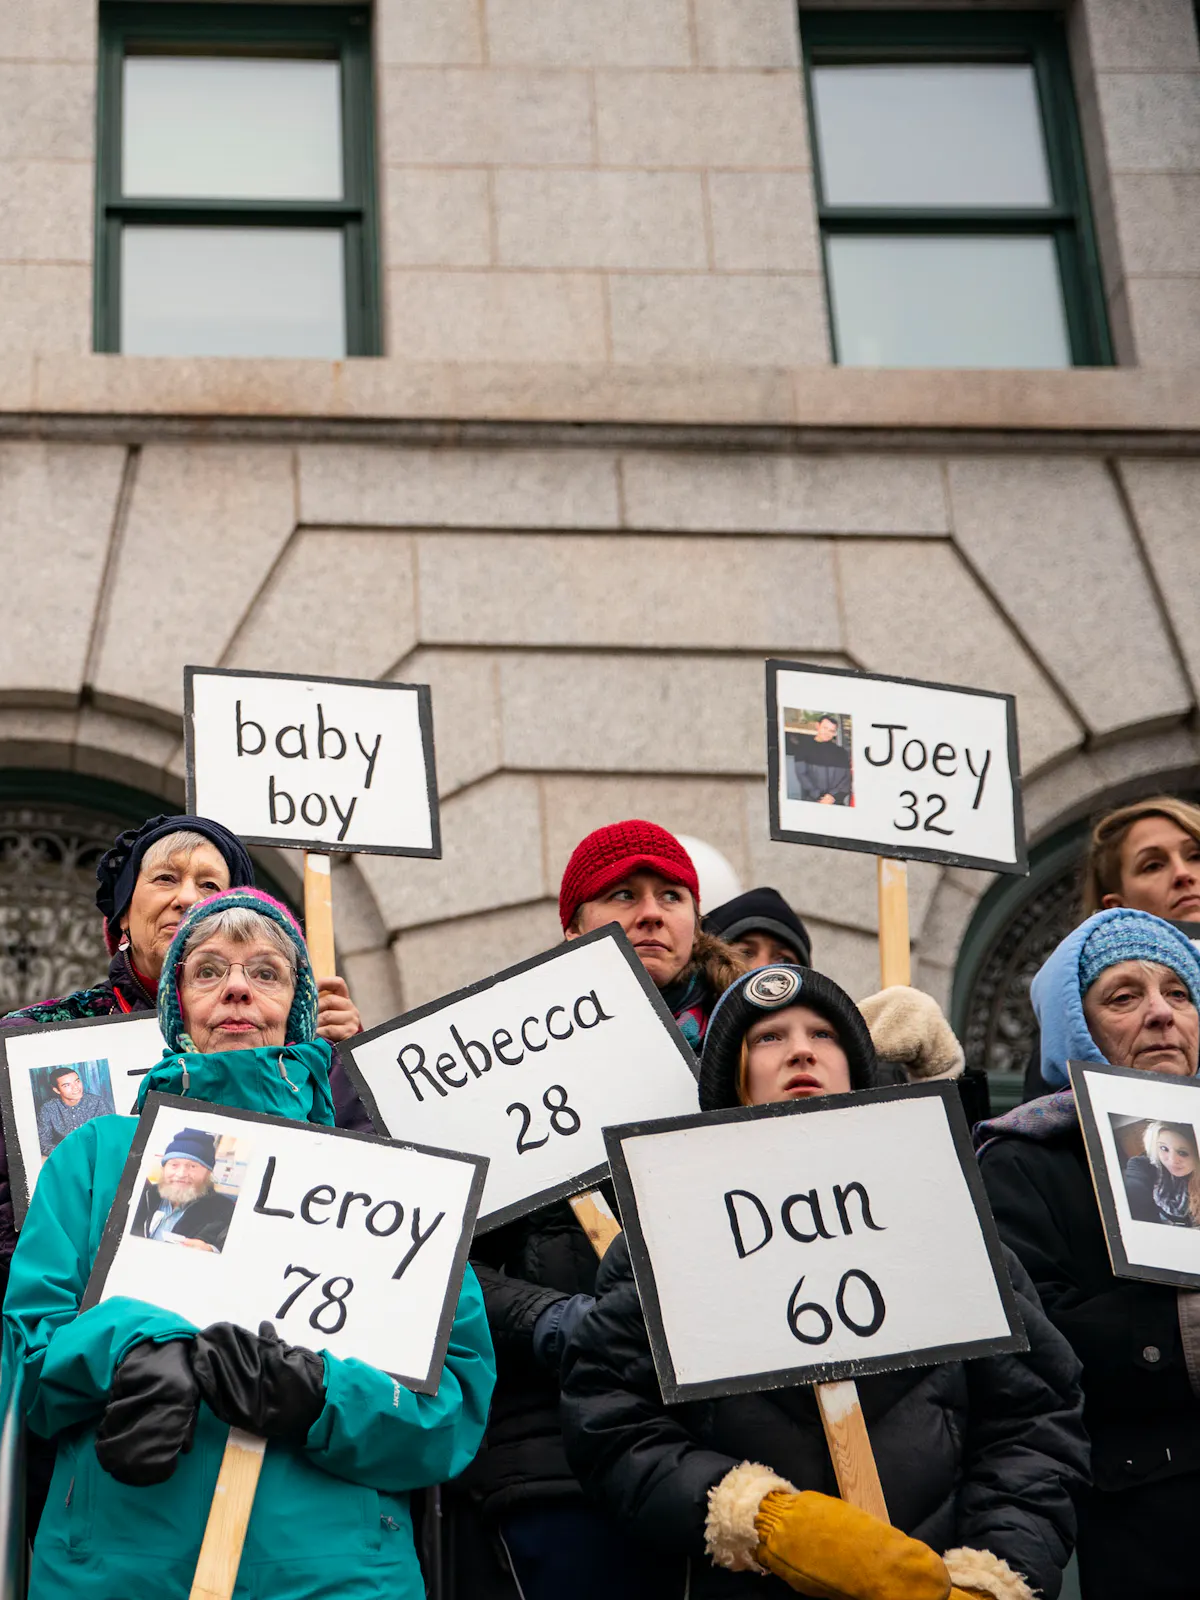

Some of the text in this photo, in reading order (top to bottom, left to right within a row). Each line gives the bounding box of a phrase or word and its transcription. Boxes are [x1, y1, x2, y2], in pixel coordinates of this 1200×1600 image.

[234, 699, 383, 790] baby
[863, 722, 992, 810] Joey
[267, 774, 358, 842] boy
[893, 790, 954, 836] 32
[395, 989, 616, 1103] Rebecca
[505, 1083, 582, 1156] 28
[254, 1155, 447, 1280] Leroy
[724, 1181, 887, 1259] Dan
[275, 1263, 355, 1335] 78
[786, 1268, 887, 1346] 60
